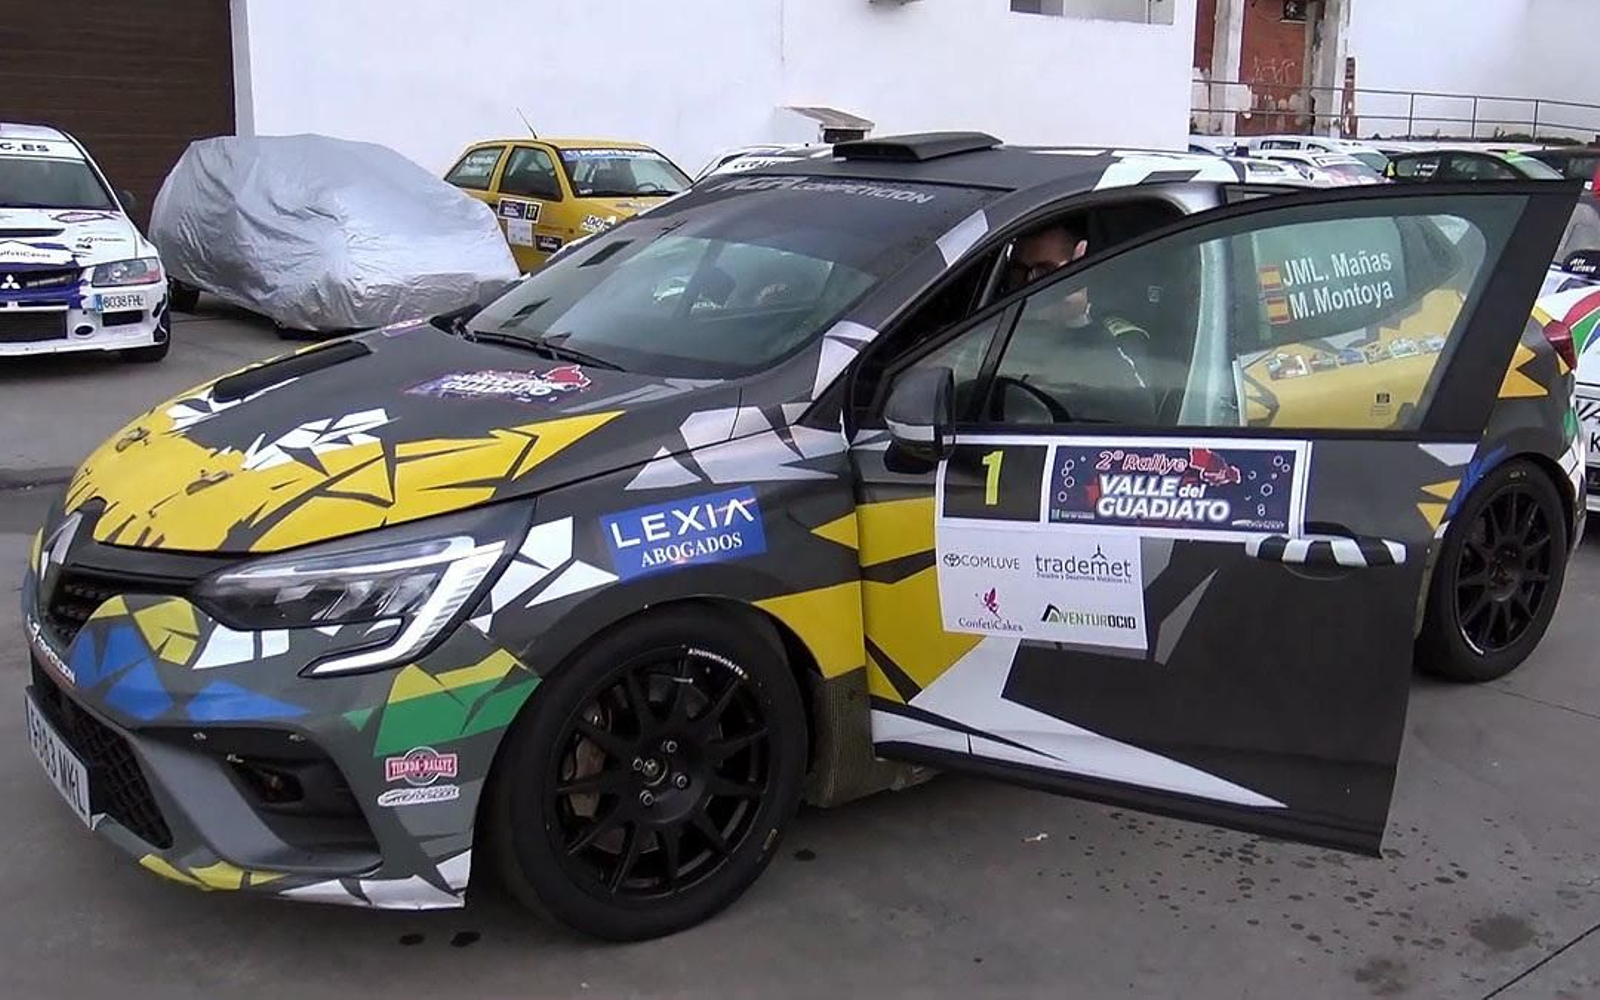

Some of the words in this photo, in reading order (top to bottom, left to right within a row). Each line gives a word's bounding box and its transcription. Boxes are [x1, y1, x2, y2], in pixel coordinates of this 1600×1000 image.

[1283, 256, 1330, 287] JML.
[1331, 250, 1393, 278] Mañas
[1122, 453, 1189, 474] Rallye
[982, 450, 1003, 505] 1
[1099, 474, 1181, 497] VALLE
[1178, 483, 1205, 498] del
[1098, 499, 1230, 521] GUADIATO
[610, 498, 755, 548] LEXIA
[641, 532, 743, 567] ABOGADOS
[962, 554, 1020, 570] COMLUVE
[1035, 553, 1132, 578] trademet
